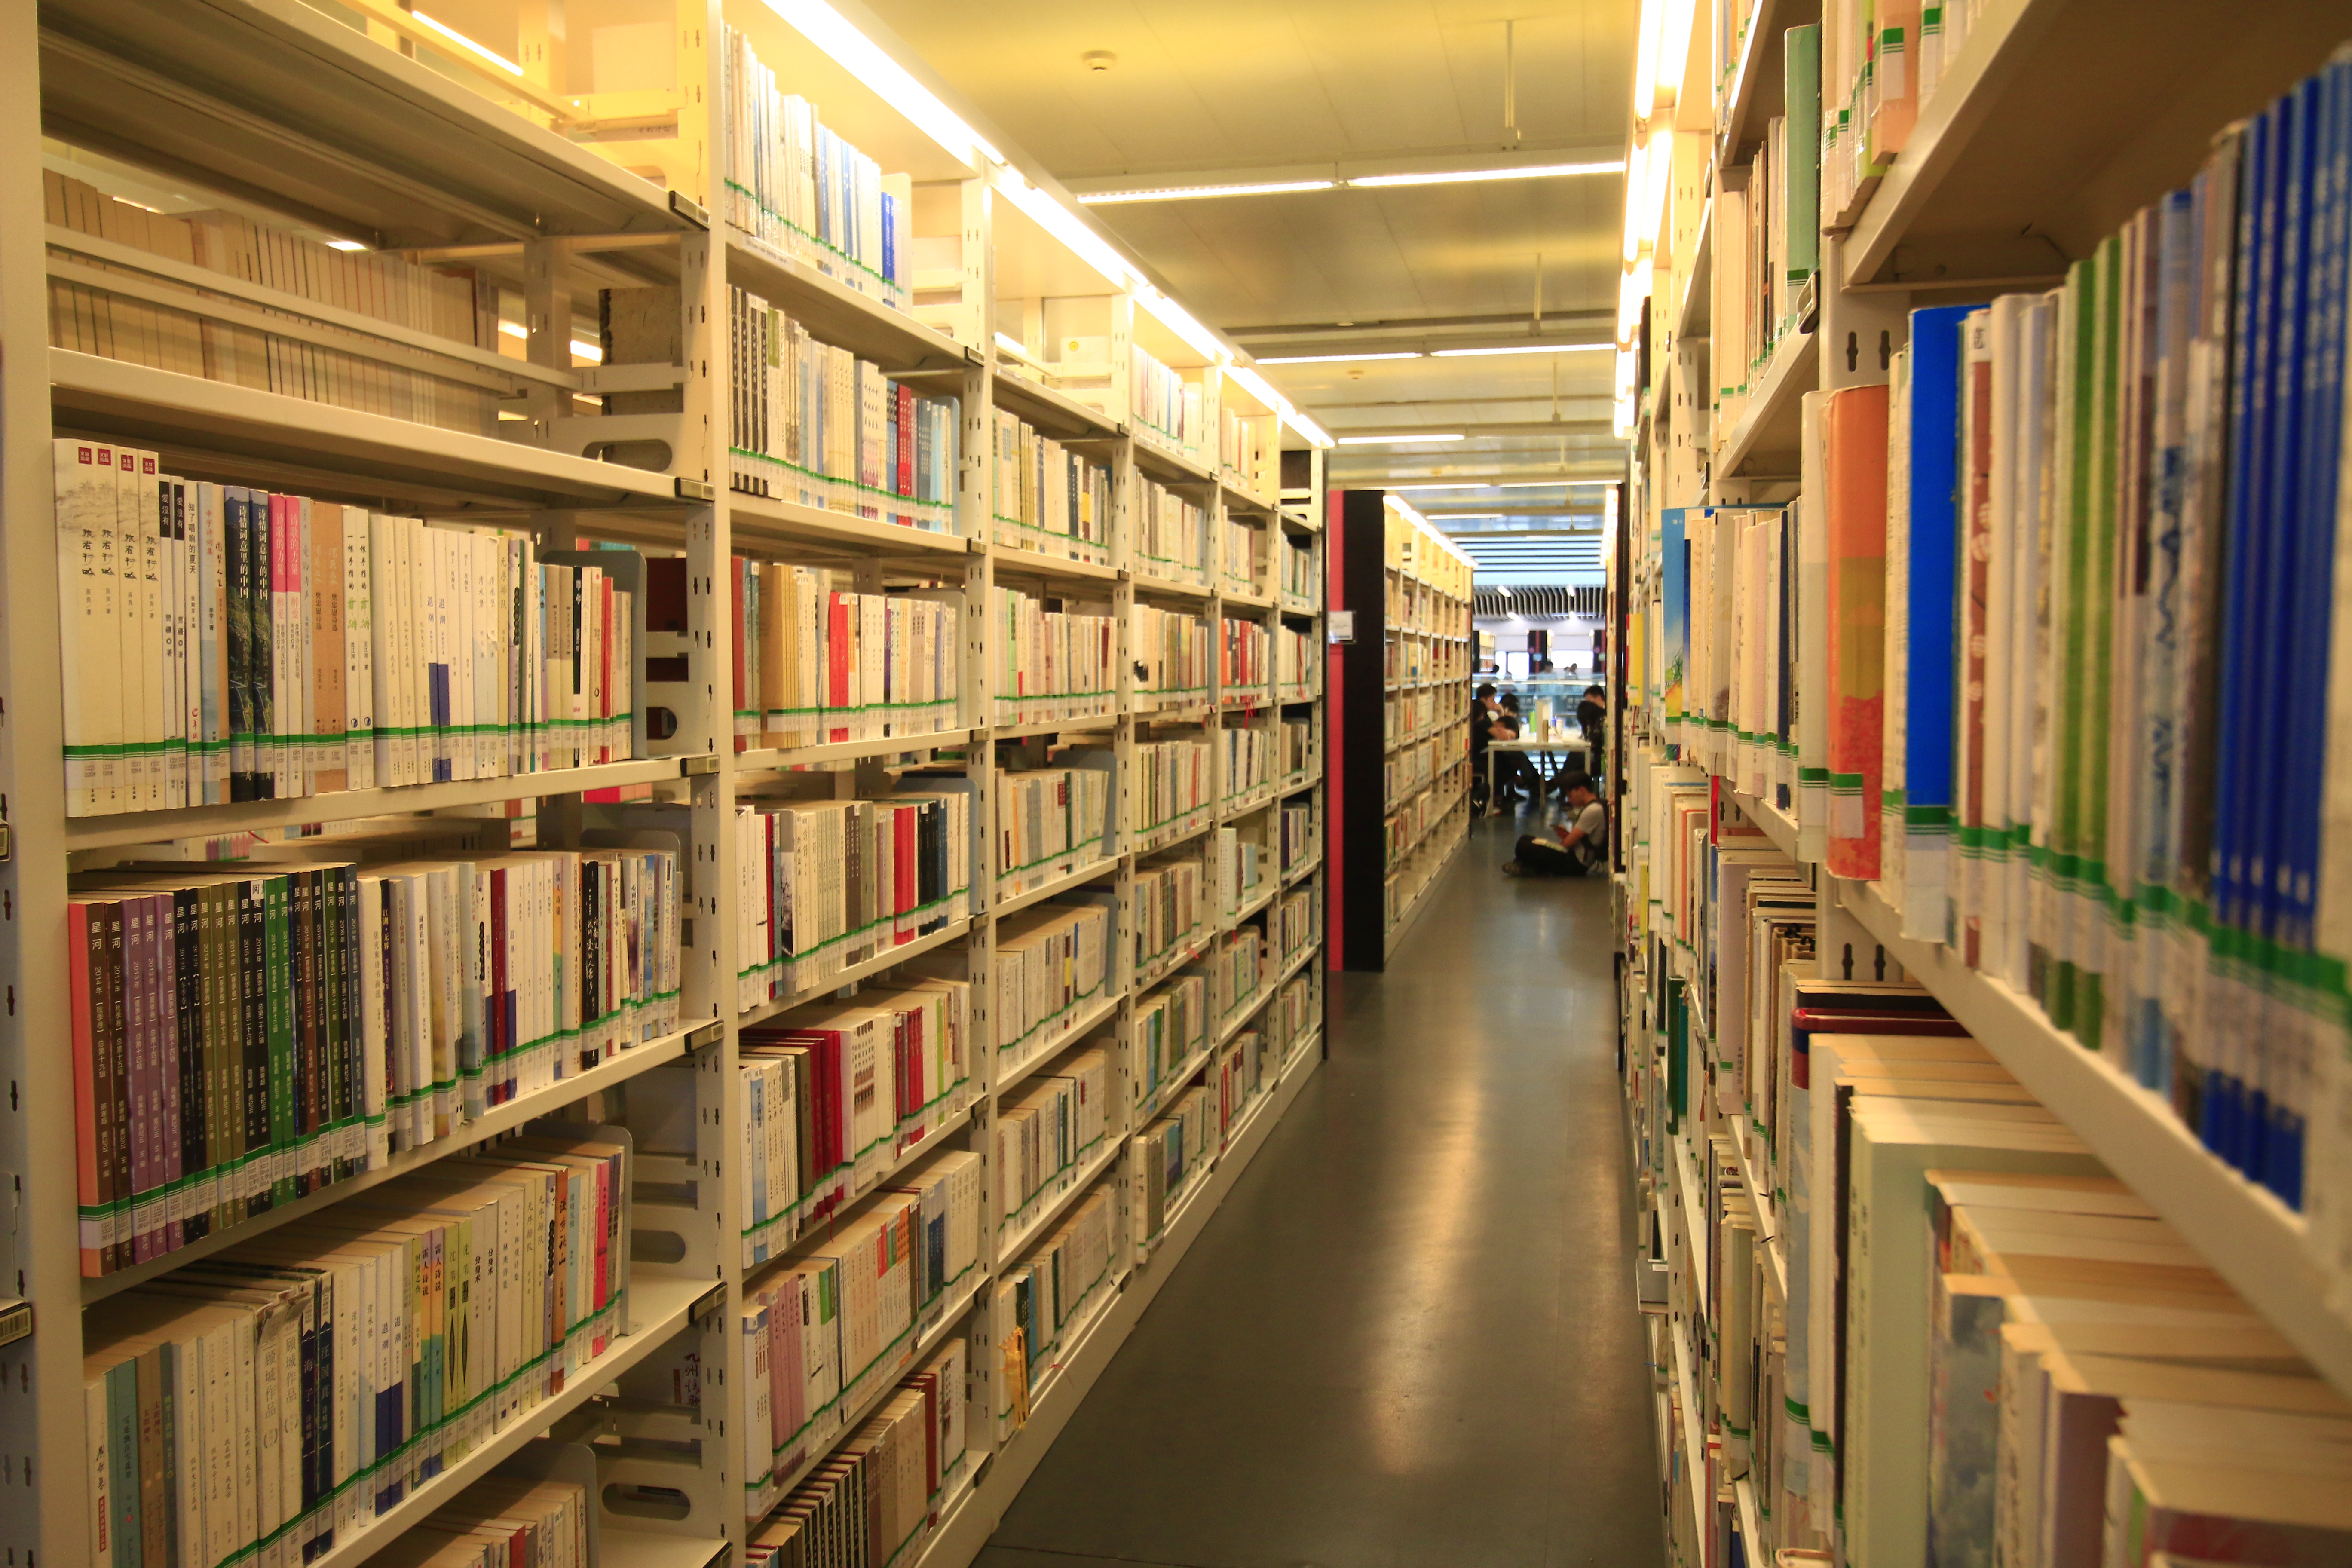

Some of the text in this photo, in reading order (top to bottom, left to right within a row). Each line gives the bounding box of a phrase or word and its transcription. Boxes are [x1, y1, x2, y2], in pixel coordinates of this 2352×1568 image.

[239, 505, 248, 600] 诗情词意里的中国
[258, 509, 268, 601] 诗情词意里的中国
[290, 514, 299, 575] 诗歌的力量
[281, 892, 288, 917] 星河
[302, 887, 309, 912] 星河
[315, 886, 321, 910] 星河
[328, 882, 334, 906] 星河
[338, 882, 344, 906] 星河
[349, 881, 356, 905] 星河
[177, 907, 185, 934] 星河
[190, 904, 198, 931] 星河
[201, 903, 209, 929] 星河
[215, 902, 223, 928] 星河
[227, 900, 235, 925] 星河
[241, 899, 249, 924] 星河
[269, 895, 276, 920] 星河
[91, 921, 102, 950] 星河
[112, 921, 121, 949] 星河
[131, 918, 140, 945] 星河
[146, 915, 154, 942] 星河
[165, 913, 173, 940] 星河
[285, 1335, 297, 1405] 顾城作品
[303, 1358, 314, 1402] 海子
[321, 1344, 330, 1401] 汪国真
[265, 1349, 276, 1419] 顾城作品
